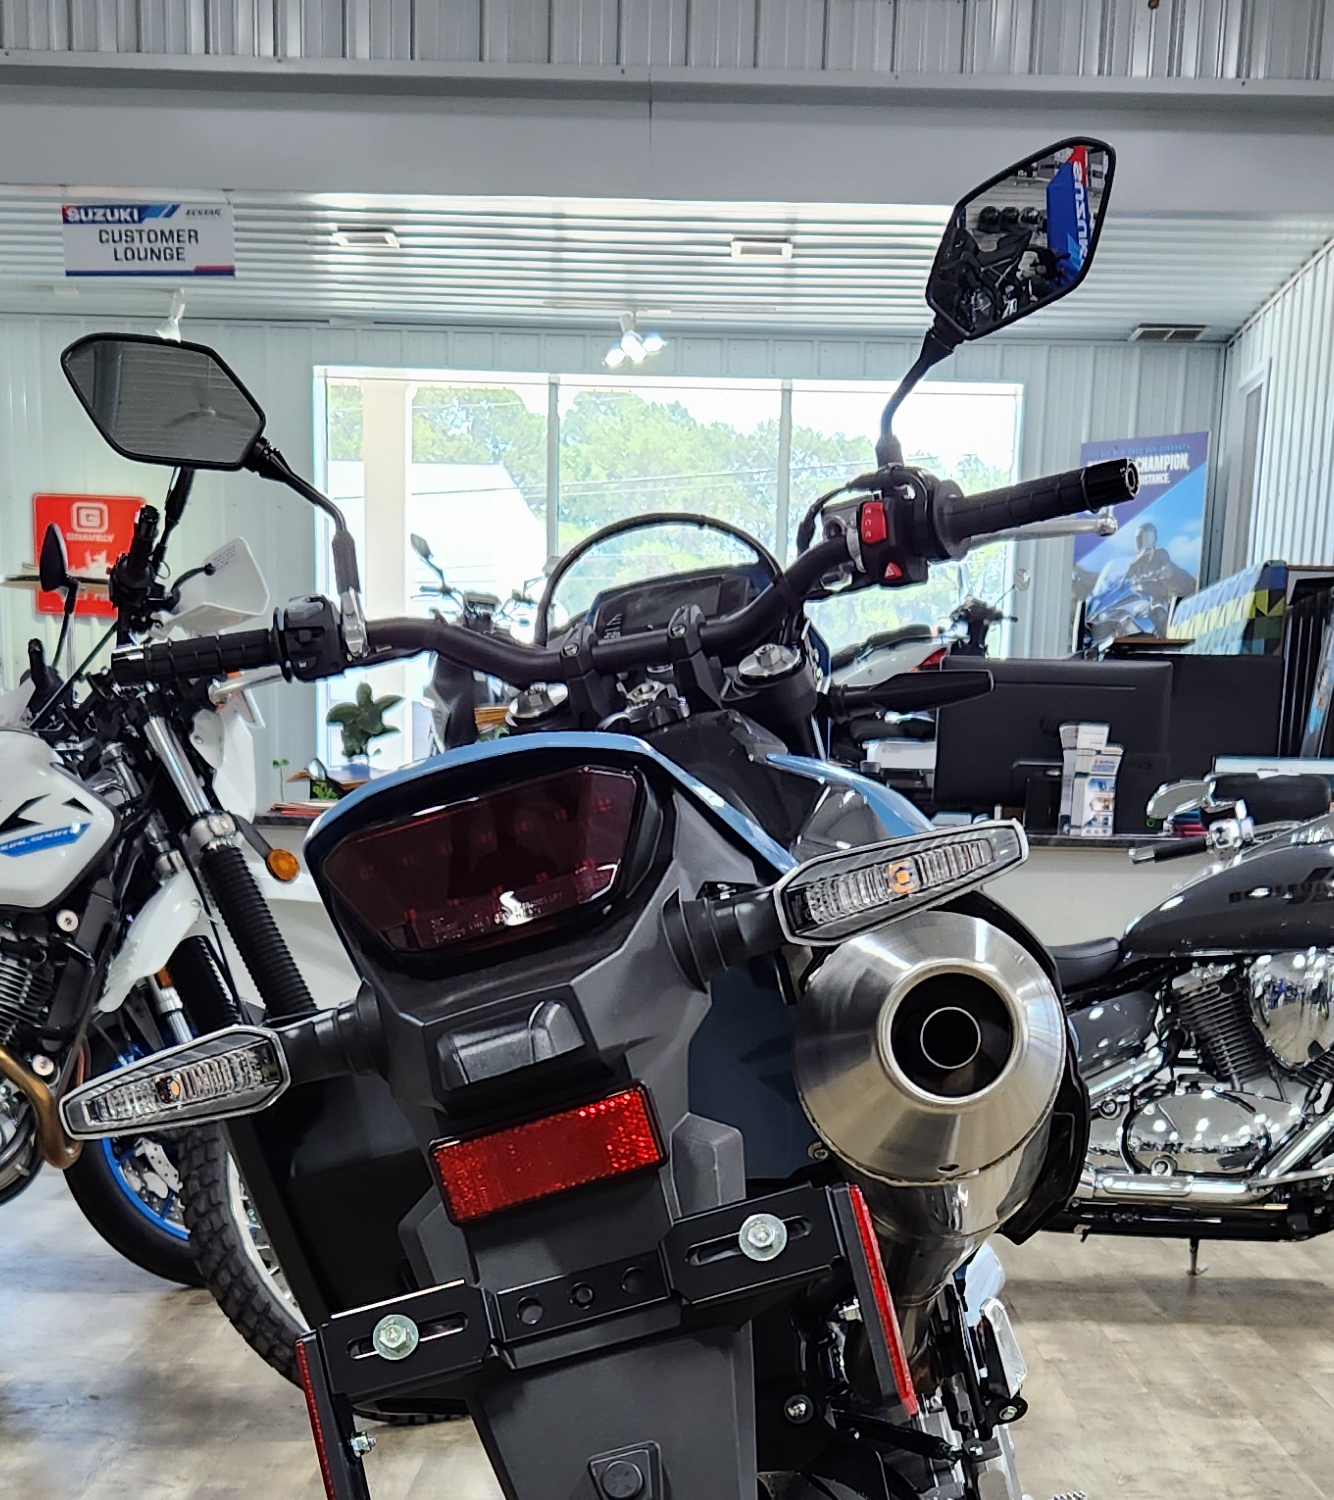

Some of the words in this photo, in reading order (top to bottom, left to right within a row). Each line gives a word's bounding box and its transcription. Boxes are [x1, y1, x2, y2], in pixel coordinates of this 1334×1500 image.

[67, 207, 140, 223] SUZUKI
[98, 229, 199, 245] CUSTOMER
[113, 246, 186, 262] LOUNGE
